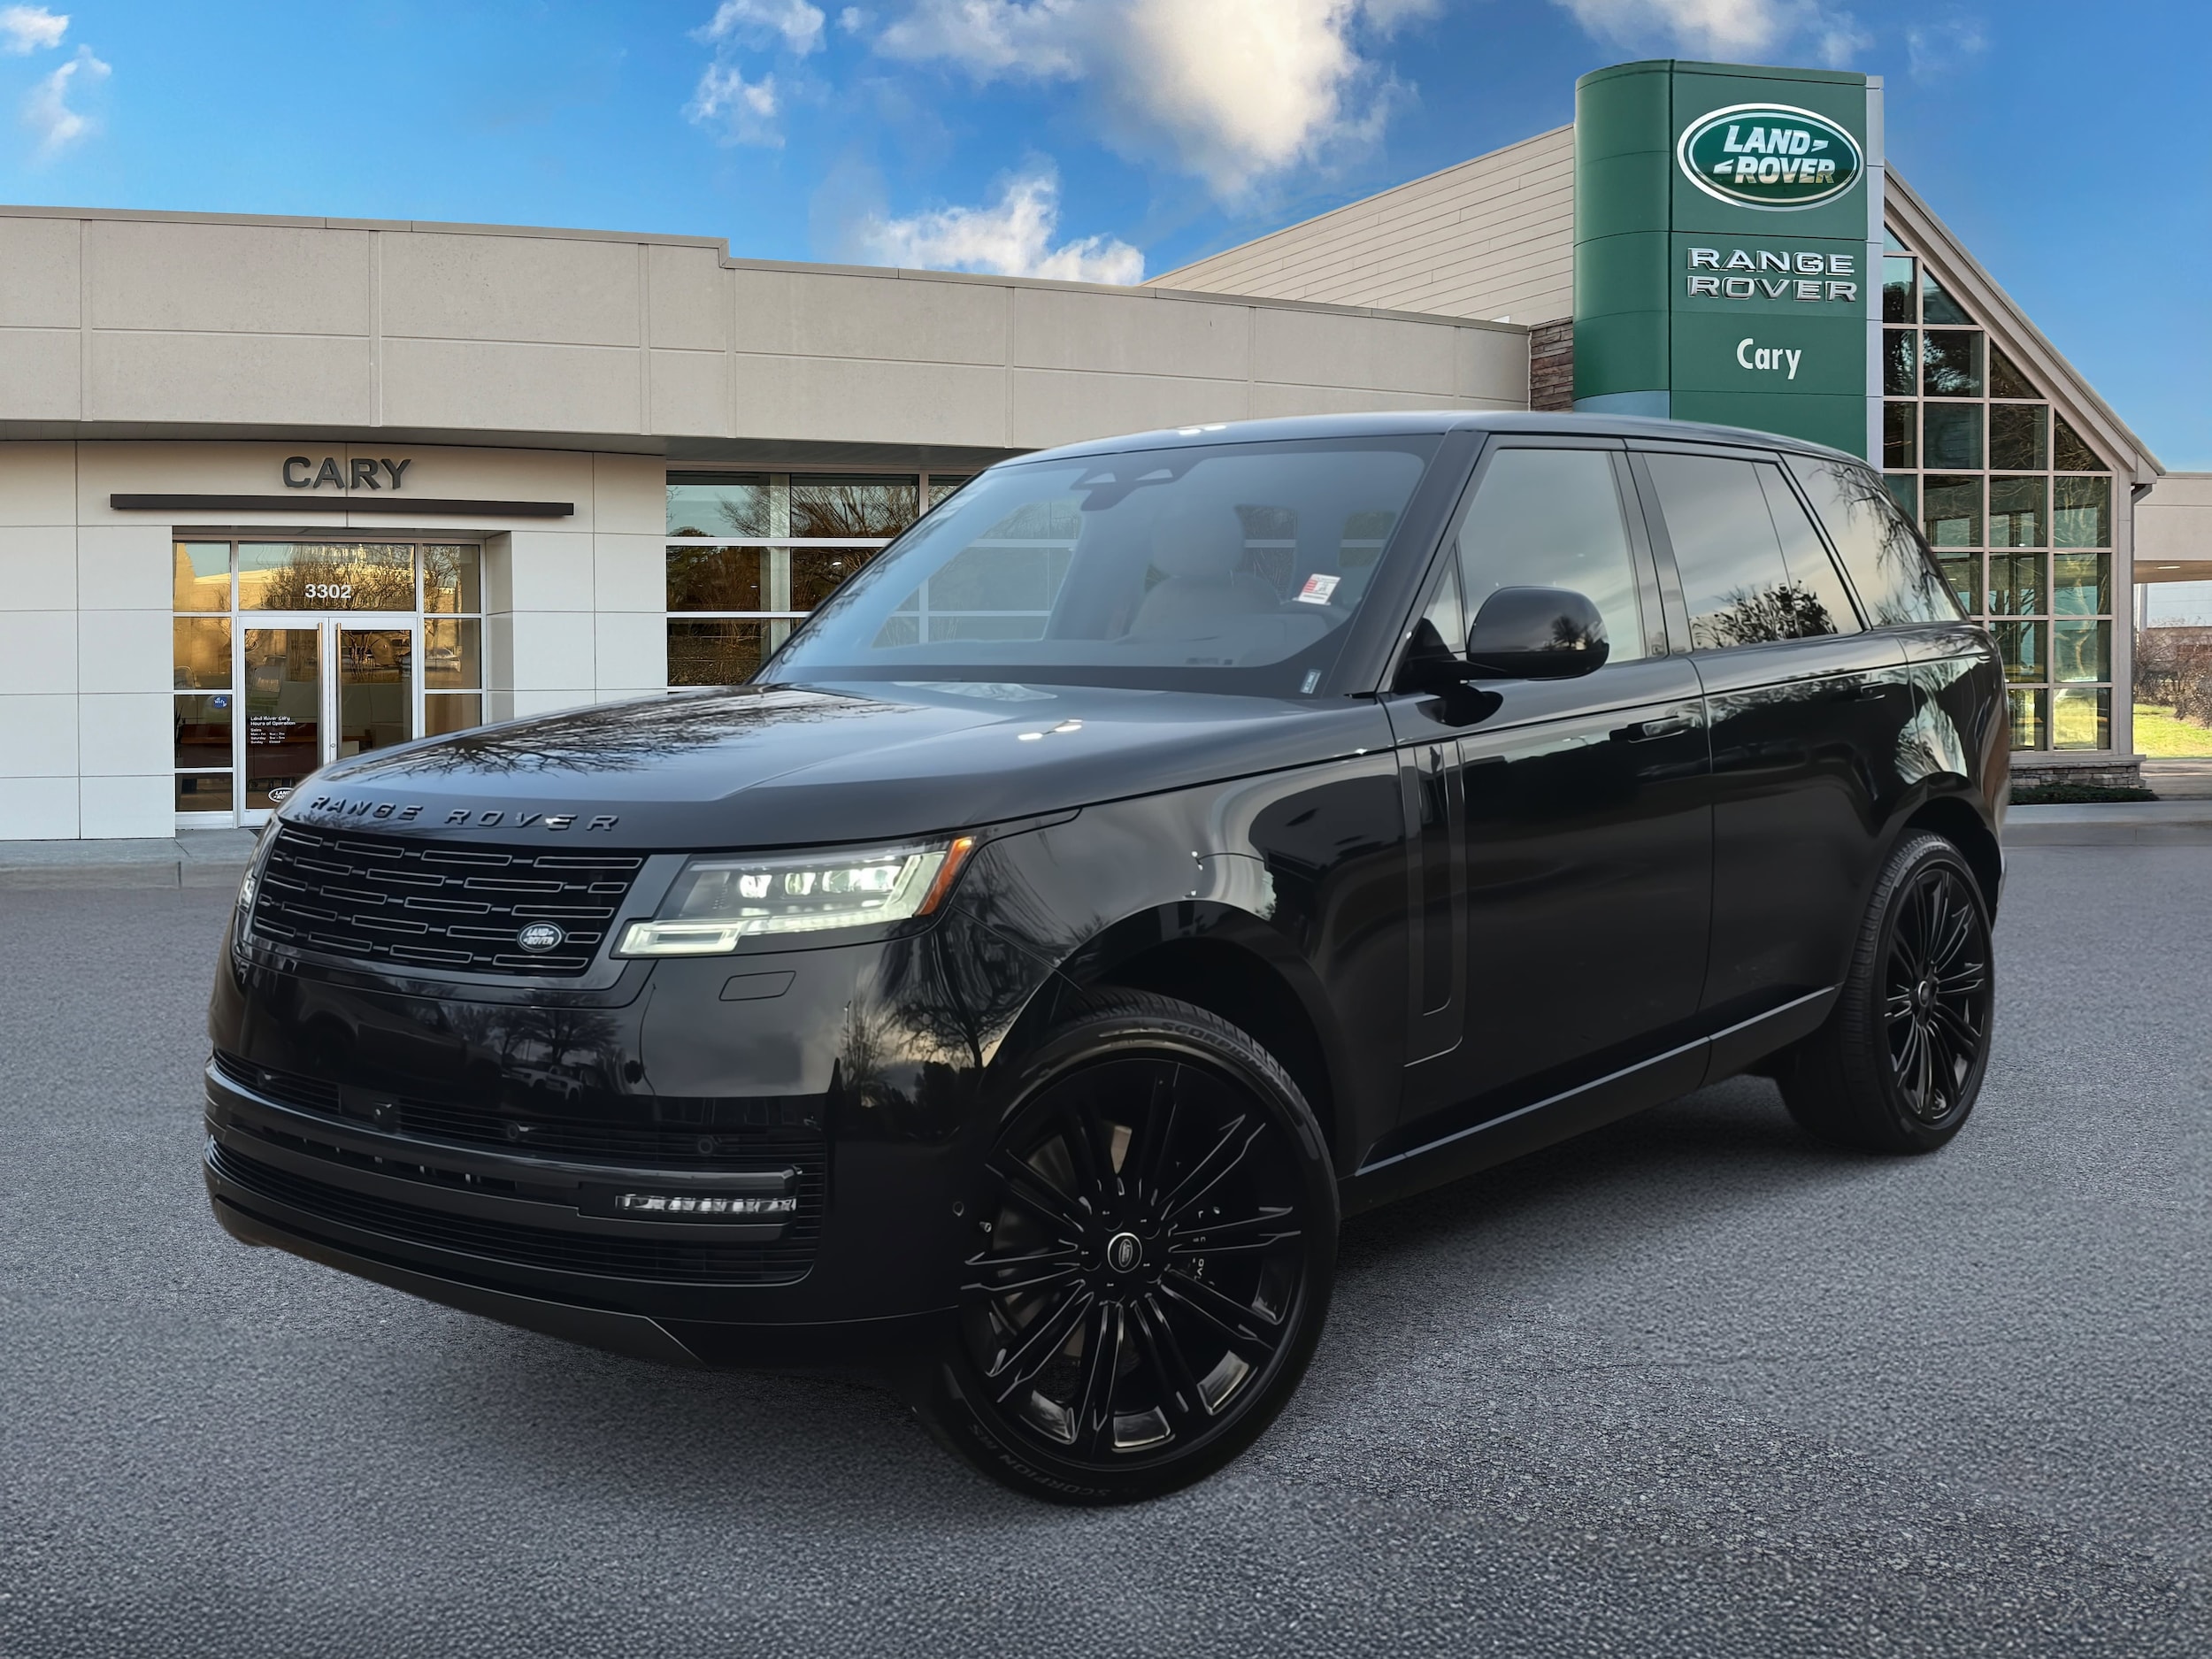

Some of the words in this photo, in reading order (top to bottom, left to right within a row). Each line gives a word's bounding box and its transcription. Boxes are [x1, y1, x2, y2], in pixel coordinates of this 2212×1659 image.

[1723, 124, 1812, 155] LAND
[1734, 156, 1836, 184] ROVER
[1686, 247, 1855, 276] RANGE
[1686, 275, 1858, 303] ROVER
[1736, 338, 1802, 380] Cary
[282, 456, 412, 490] CARY
[304, 583, 352, 600] 3302
[310, 795, 424, 822] RANGE
[443, 809, 619, 831] ROVER
[526, 927, 549, 937] LAND
[526, 936, 555, 946] ROVER
[1161, 1021, 1264, 1071] SCORPION
[998, 1453, 1111, 1497] SCORPION
